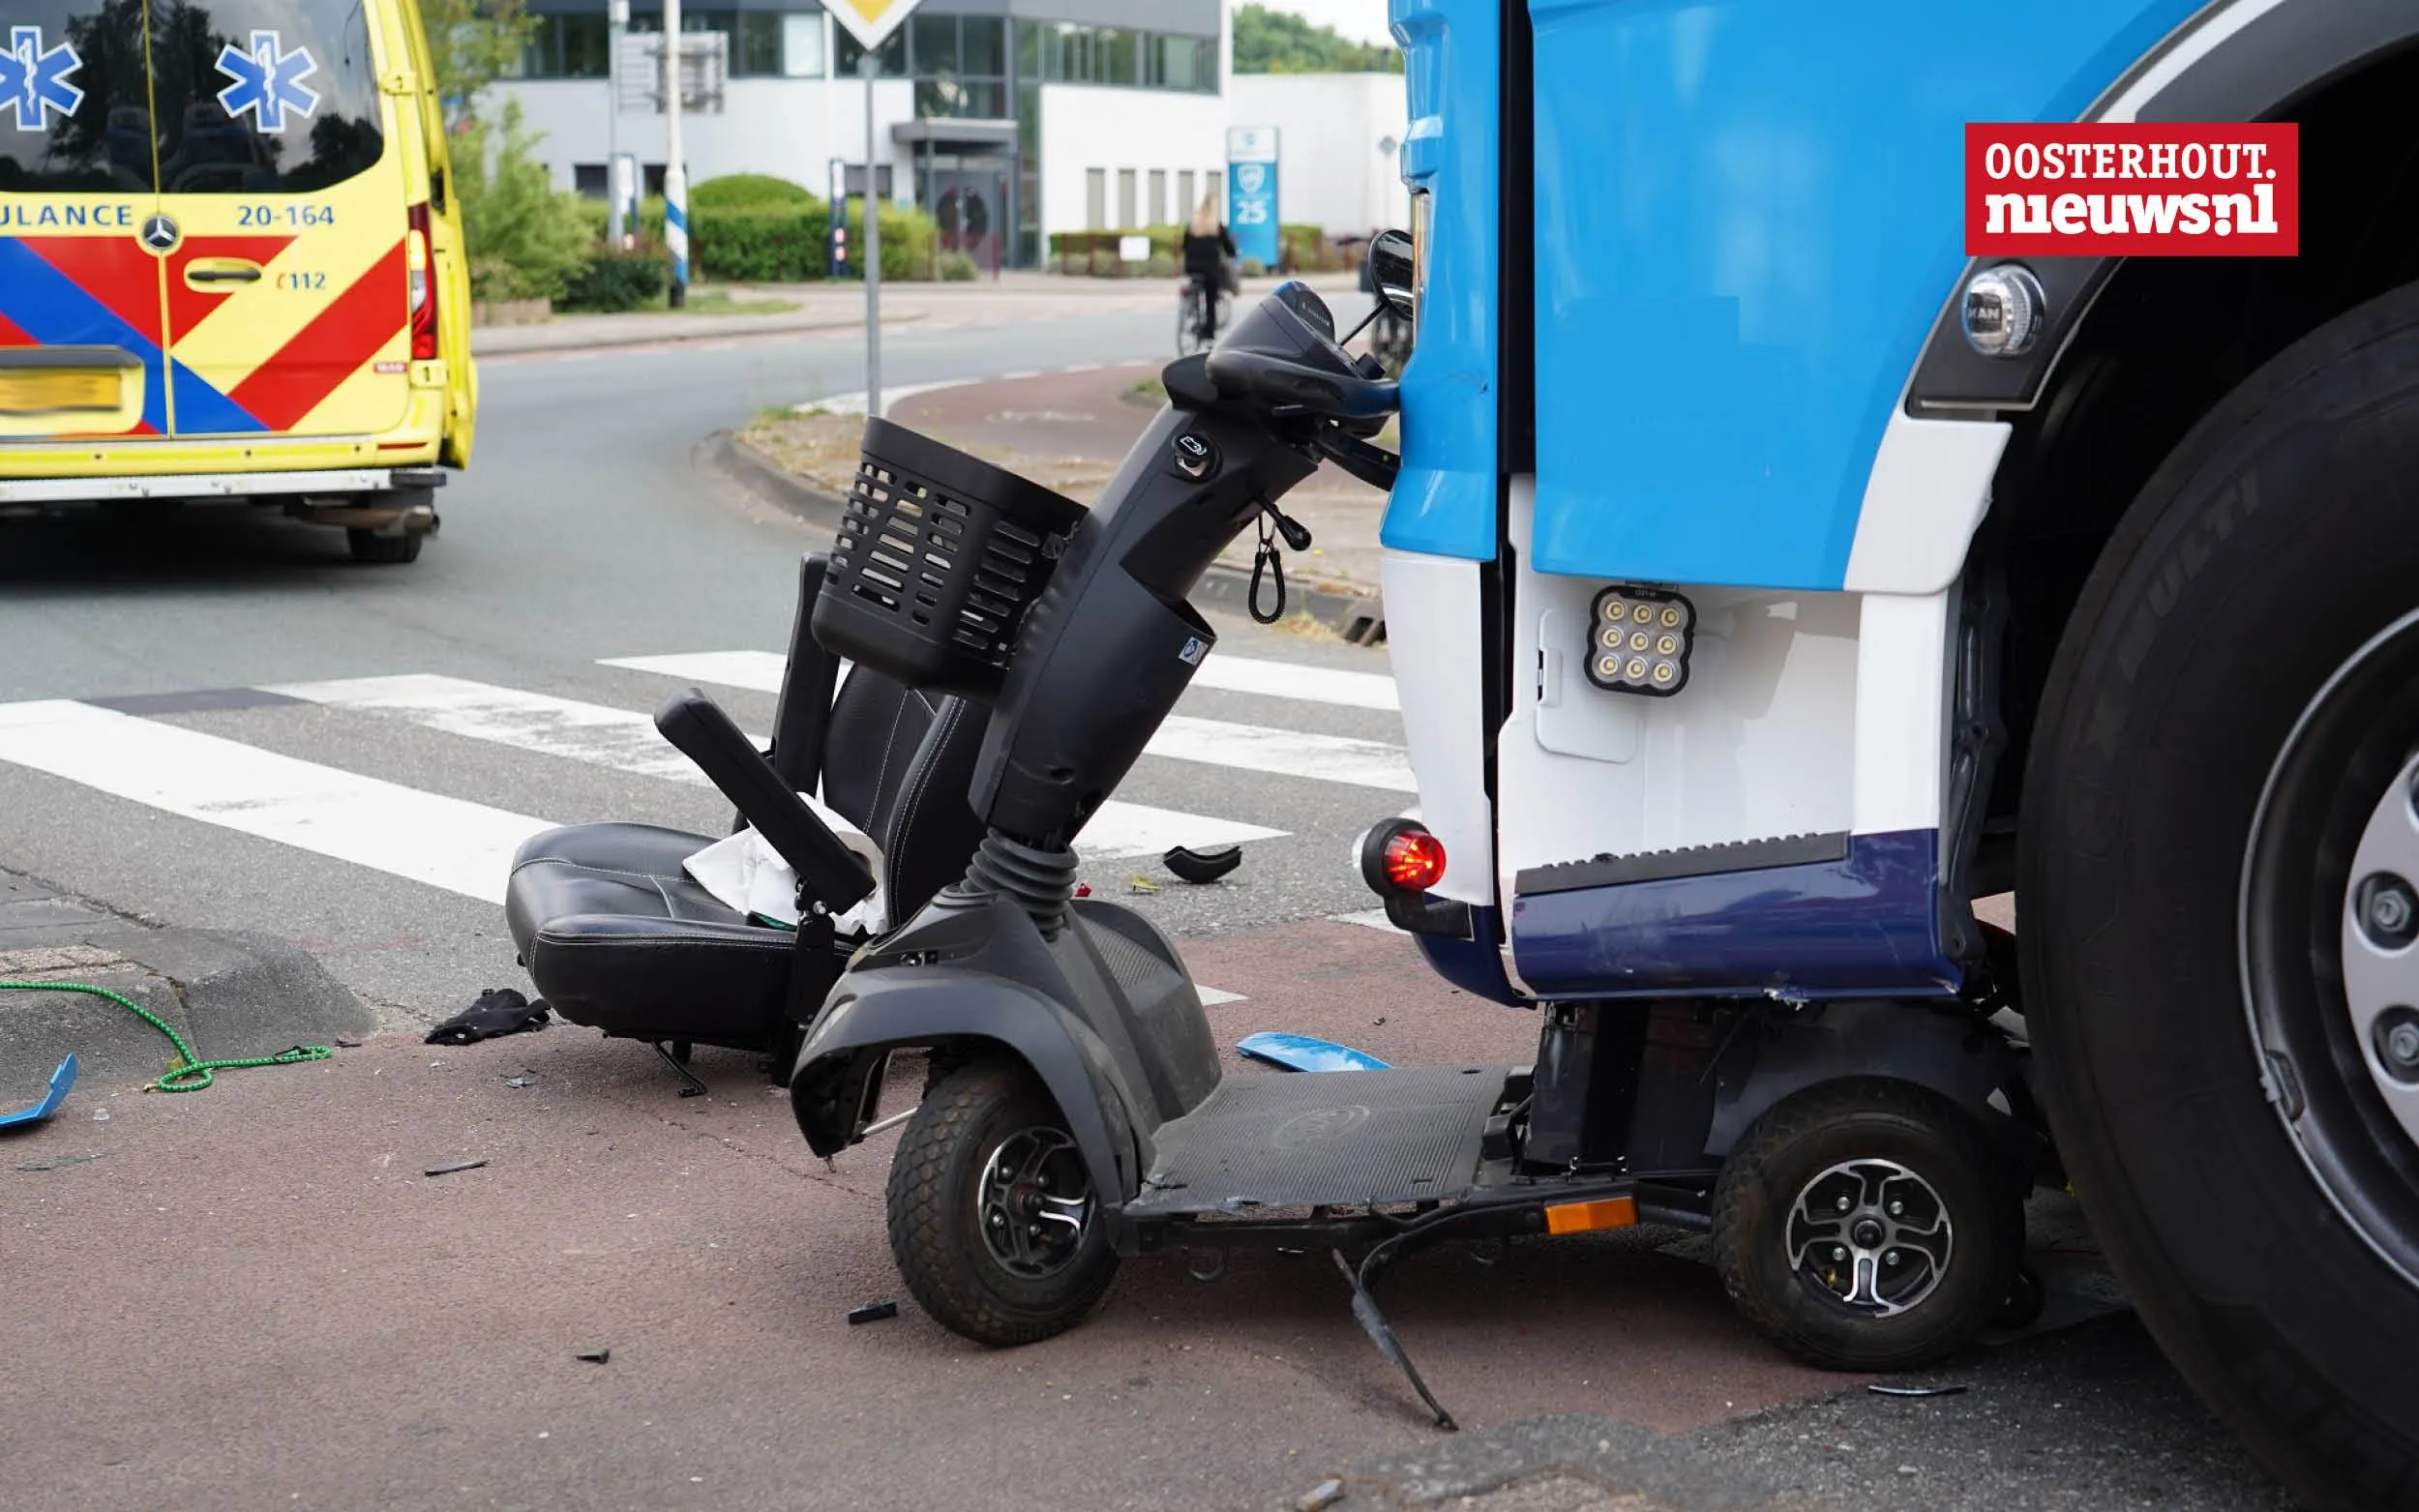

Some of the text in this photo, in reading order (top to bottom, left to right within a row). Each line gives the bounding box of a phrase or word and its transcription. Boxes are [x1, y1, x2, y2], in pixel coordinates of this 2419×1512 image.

[238, 204, 335, 225] 20-164
[1237, 200, 1268, 224] 25
[290, 272, 326, 289] 112
